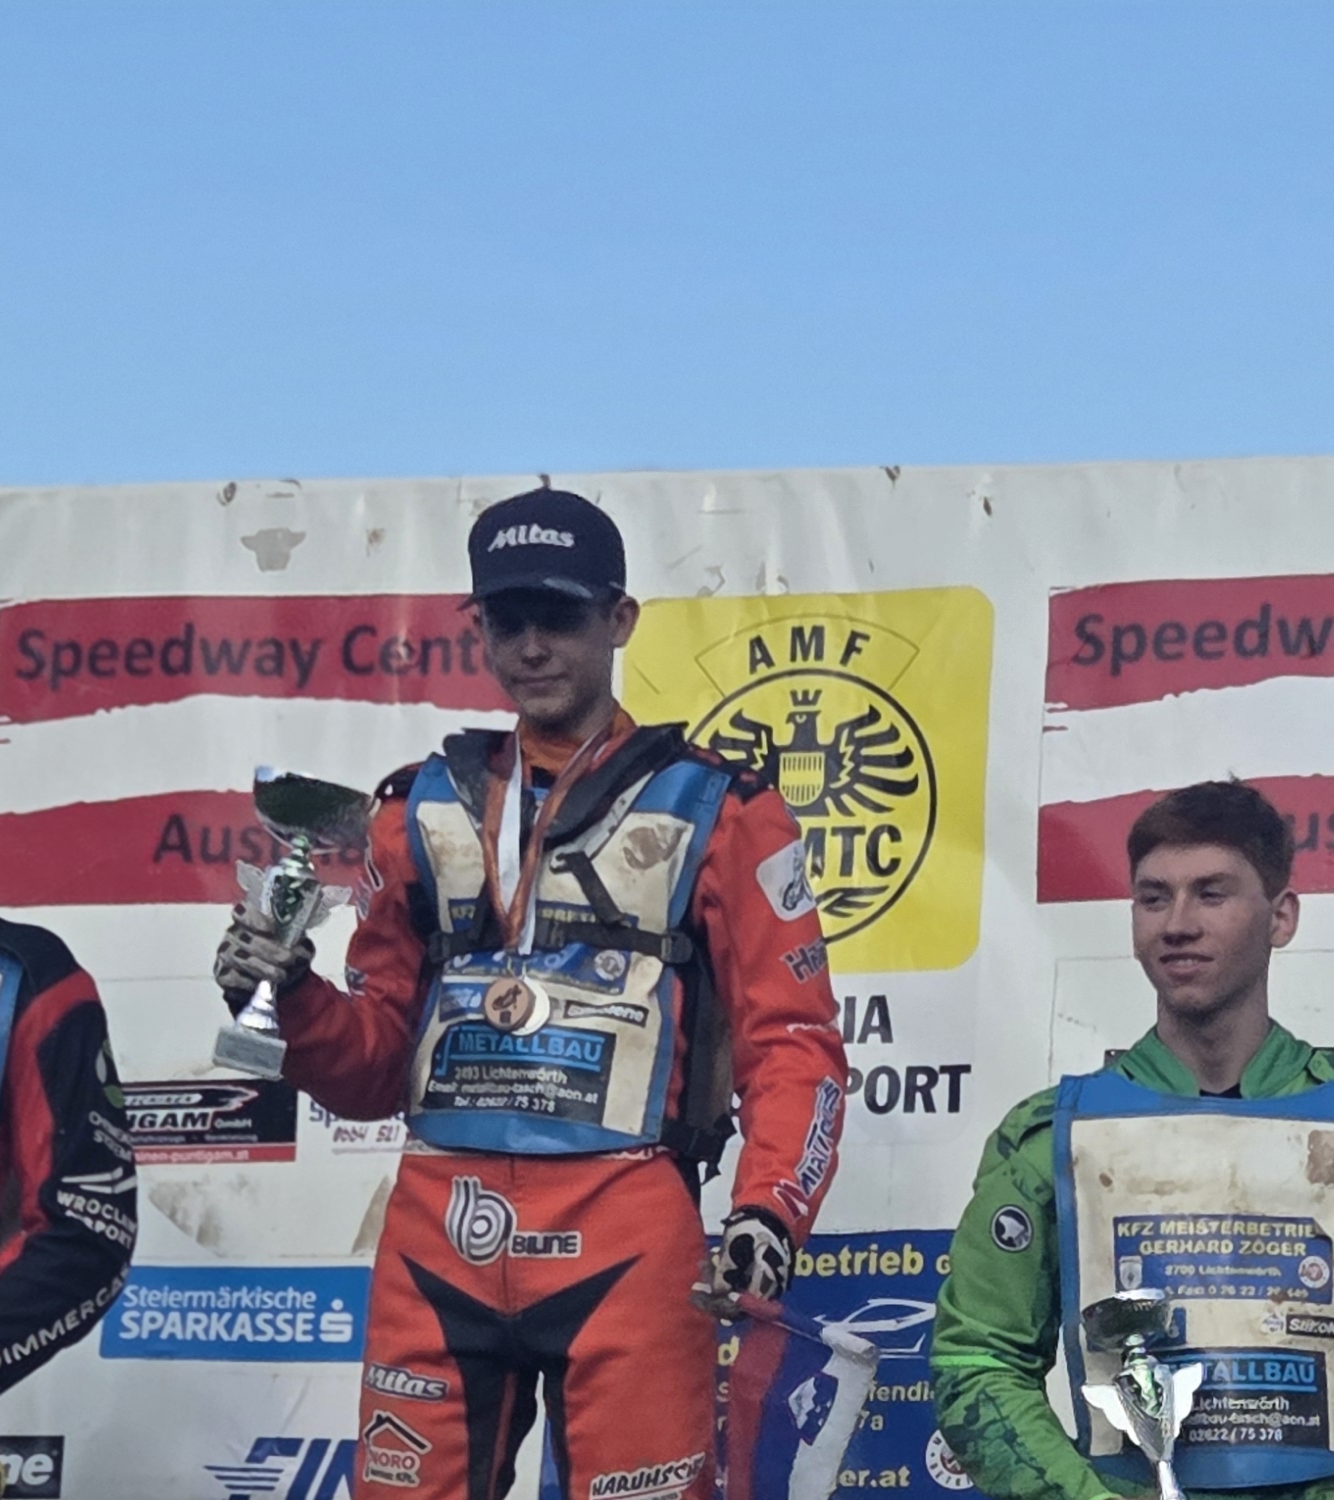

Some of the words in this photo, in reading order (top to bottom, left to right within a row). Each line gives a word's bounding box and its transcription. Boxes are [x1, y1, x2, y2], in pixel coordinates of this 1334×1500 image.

[488, 523, 575, 552] Mitas
[15, 623, 322, 690] Speedway
[341, 624, 493, 677] Cent
[748, 624, 870, 674] AMF
[802, 823, 903, 879] MTC
[458, 1033, 602, 1062] METALLBAU
[1117, 1221, 1154, 1237] KFZ
[1160, 1221, 1317, 1238] MEISTERBETRIE
[1139, 1240, 1234, 1255] GERHARD
[123, 1284, 317, 1309] Steiermärkische
[119, 1311, 315, 1342] SPARKASSE
[1167, 1361, 1315, 1384] TALLBAU
